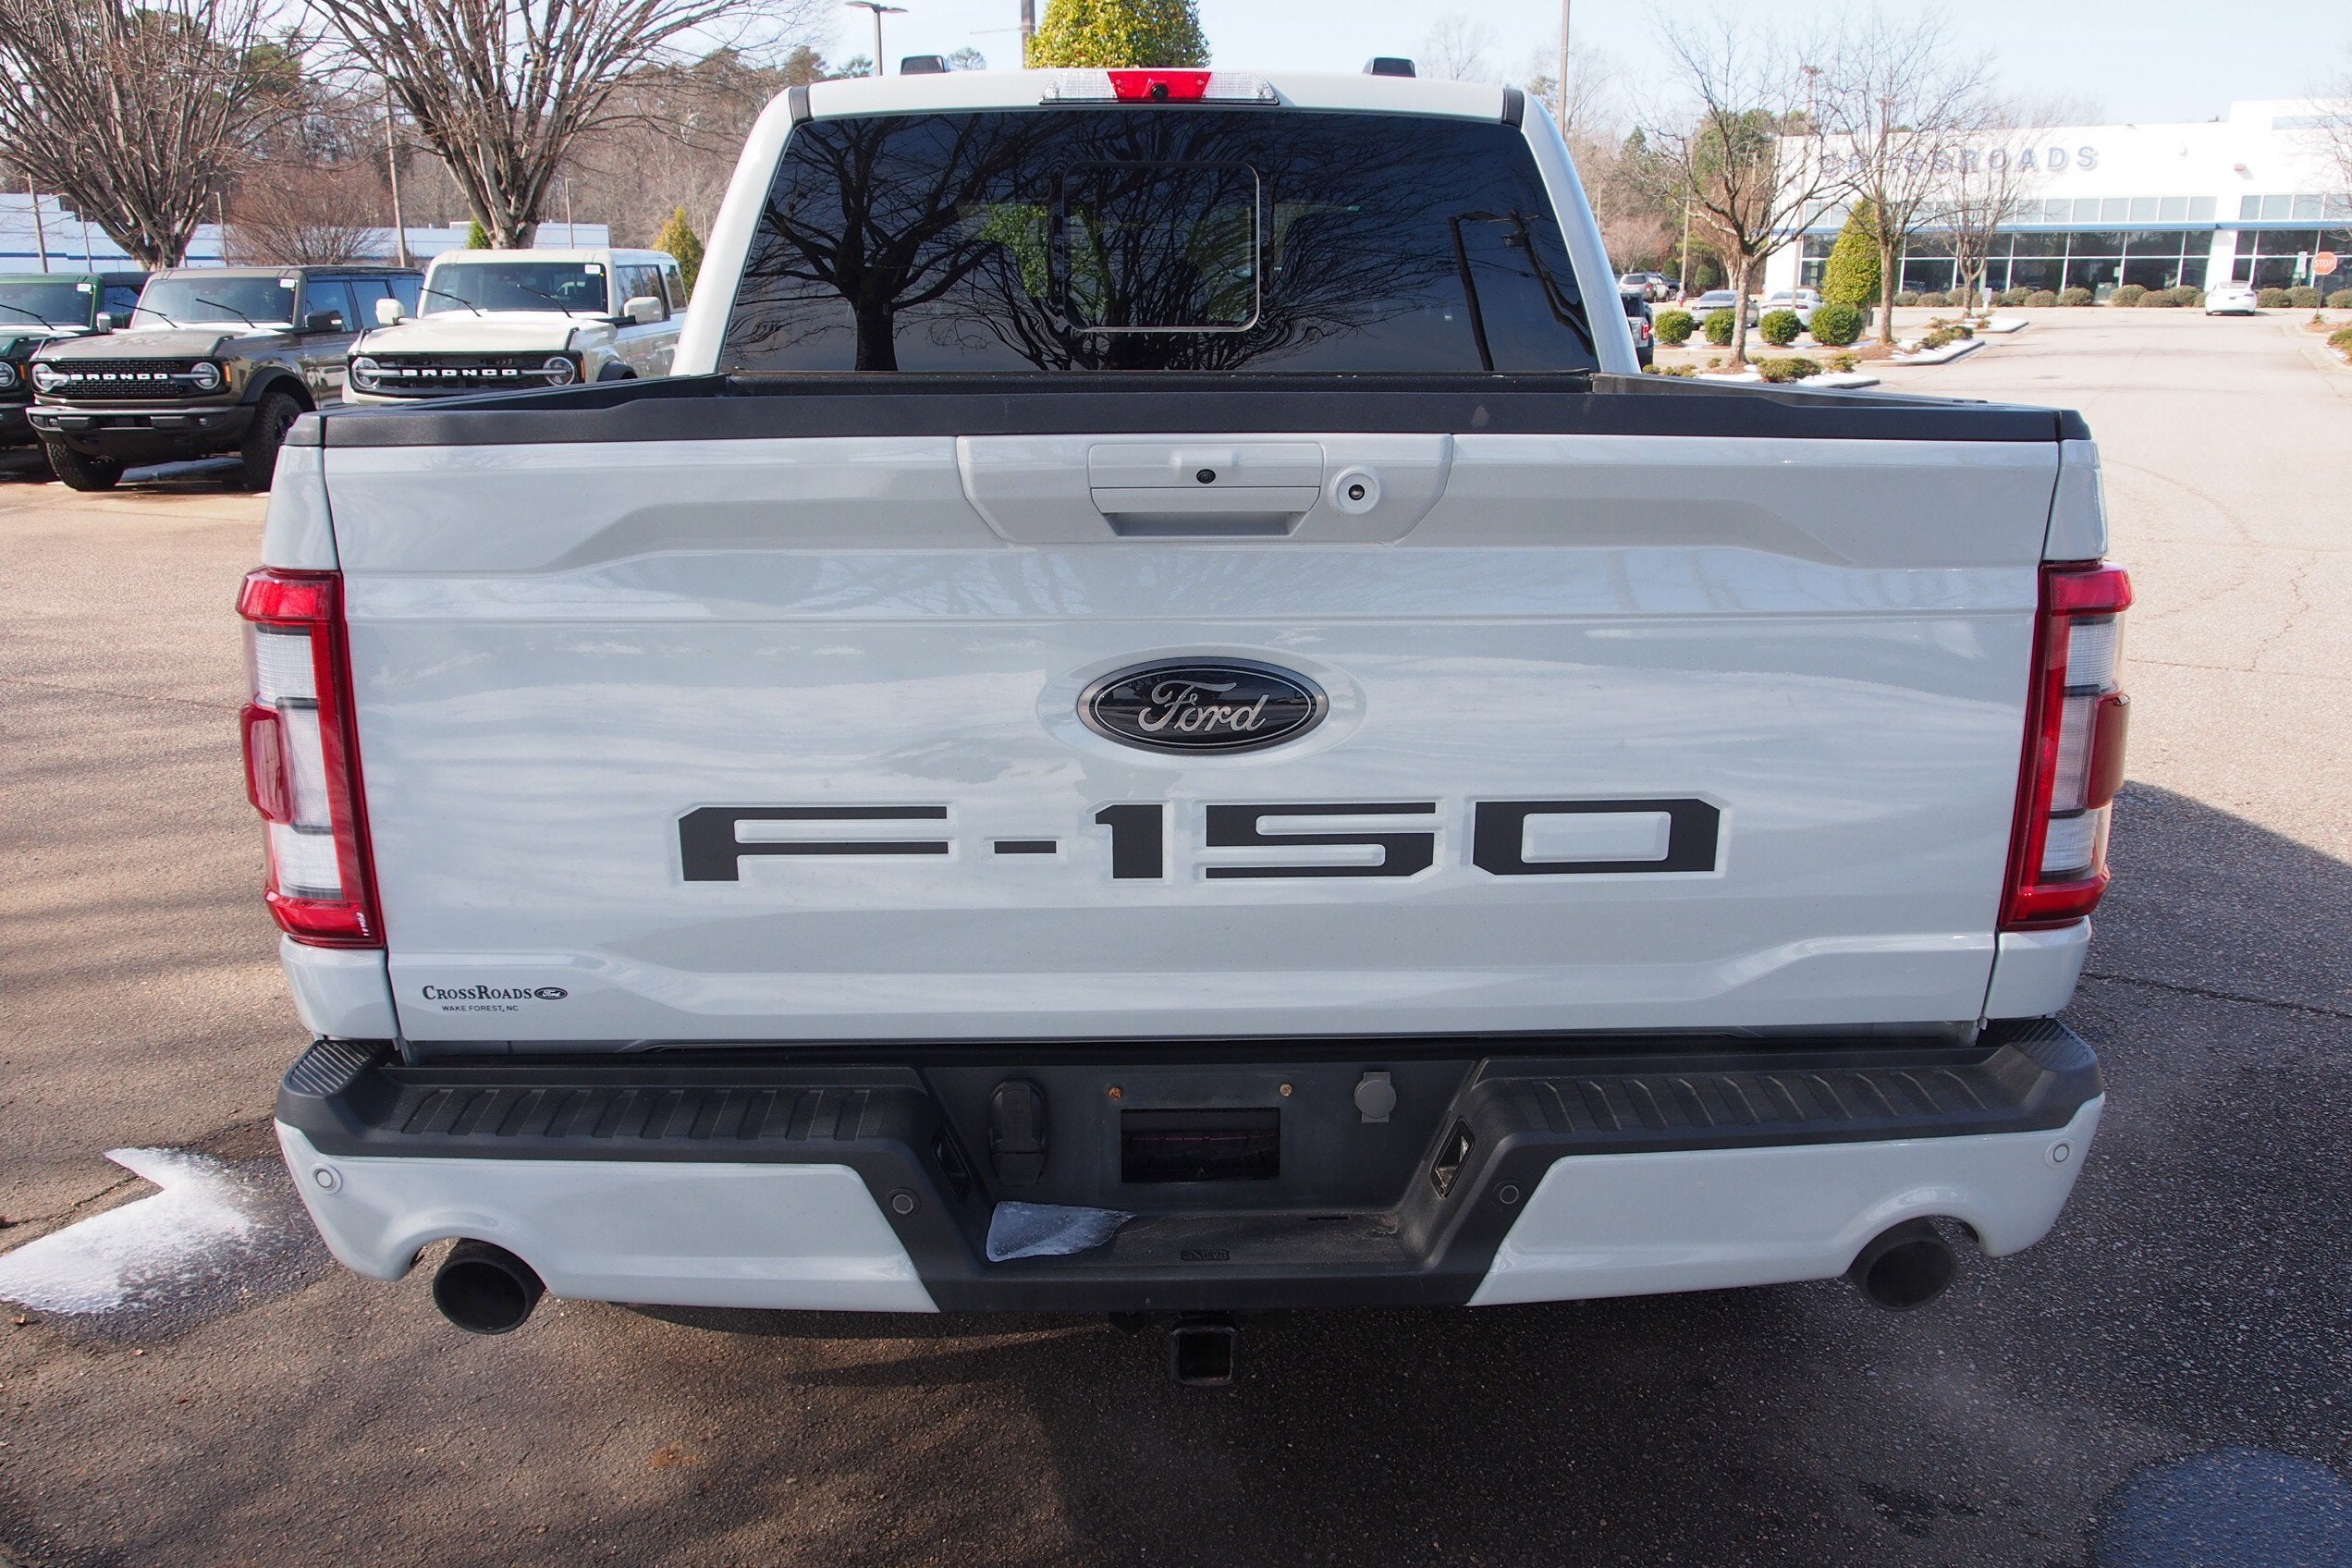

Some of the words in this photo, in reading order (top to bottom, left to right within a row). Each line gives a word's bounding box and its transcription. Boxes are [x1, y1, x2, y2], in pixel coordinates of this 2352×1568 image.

[2313, 259, 2334, 268] STOP
[402, 369, 518, 377] BRONCO
[1138, 680, 1269, 732] Ford
[678, 798, 1721, 883] F-150
[469, 1005, 506, 1013] FOREST,
